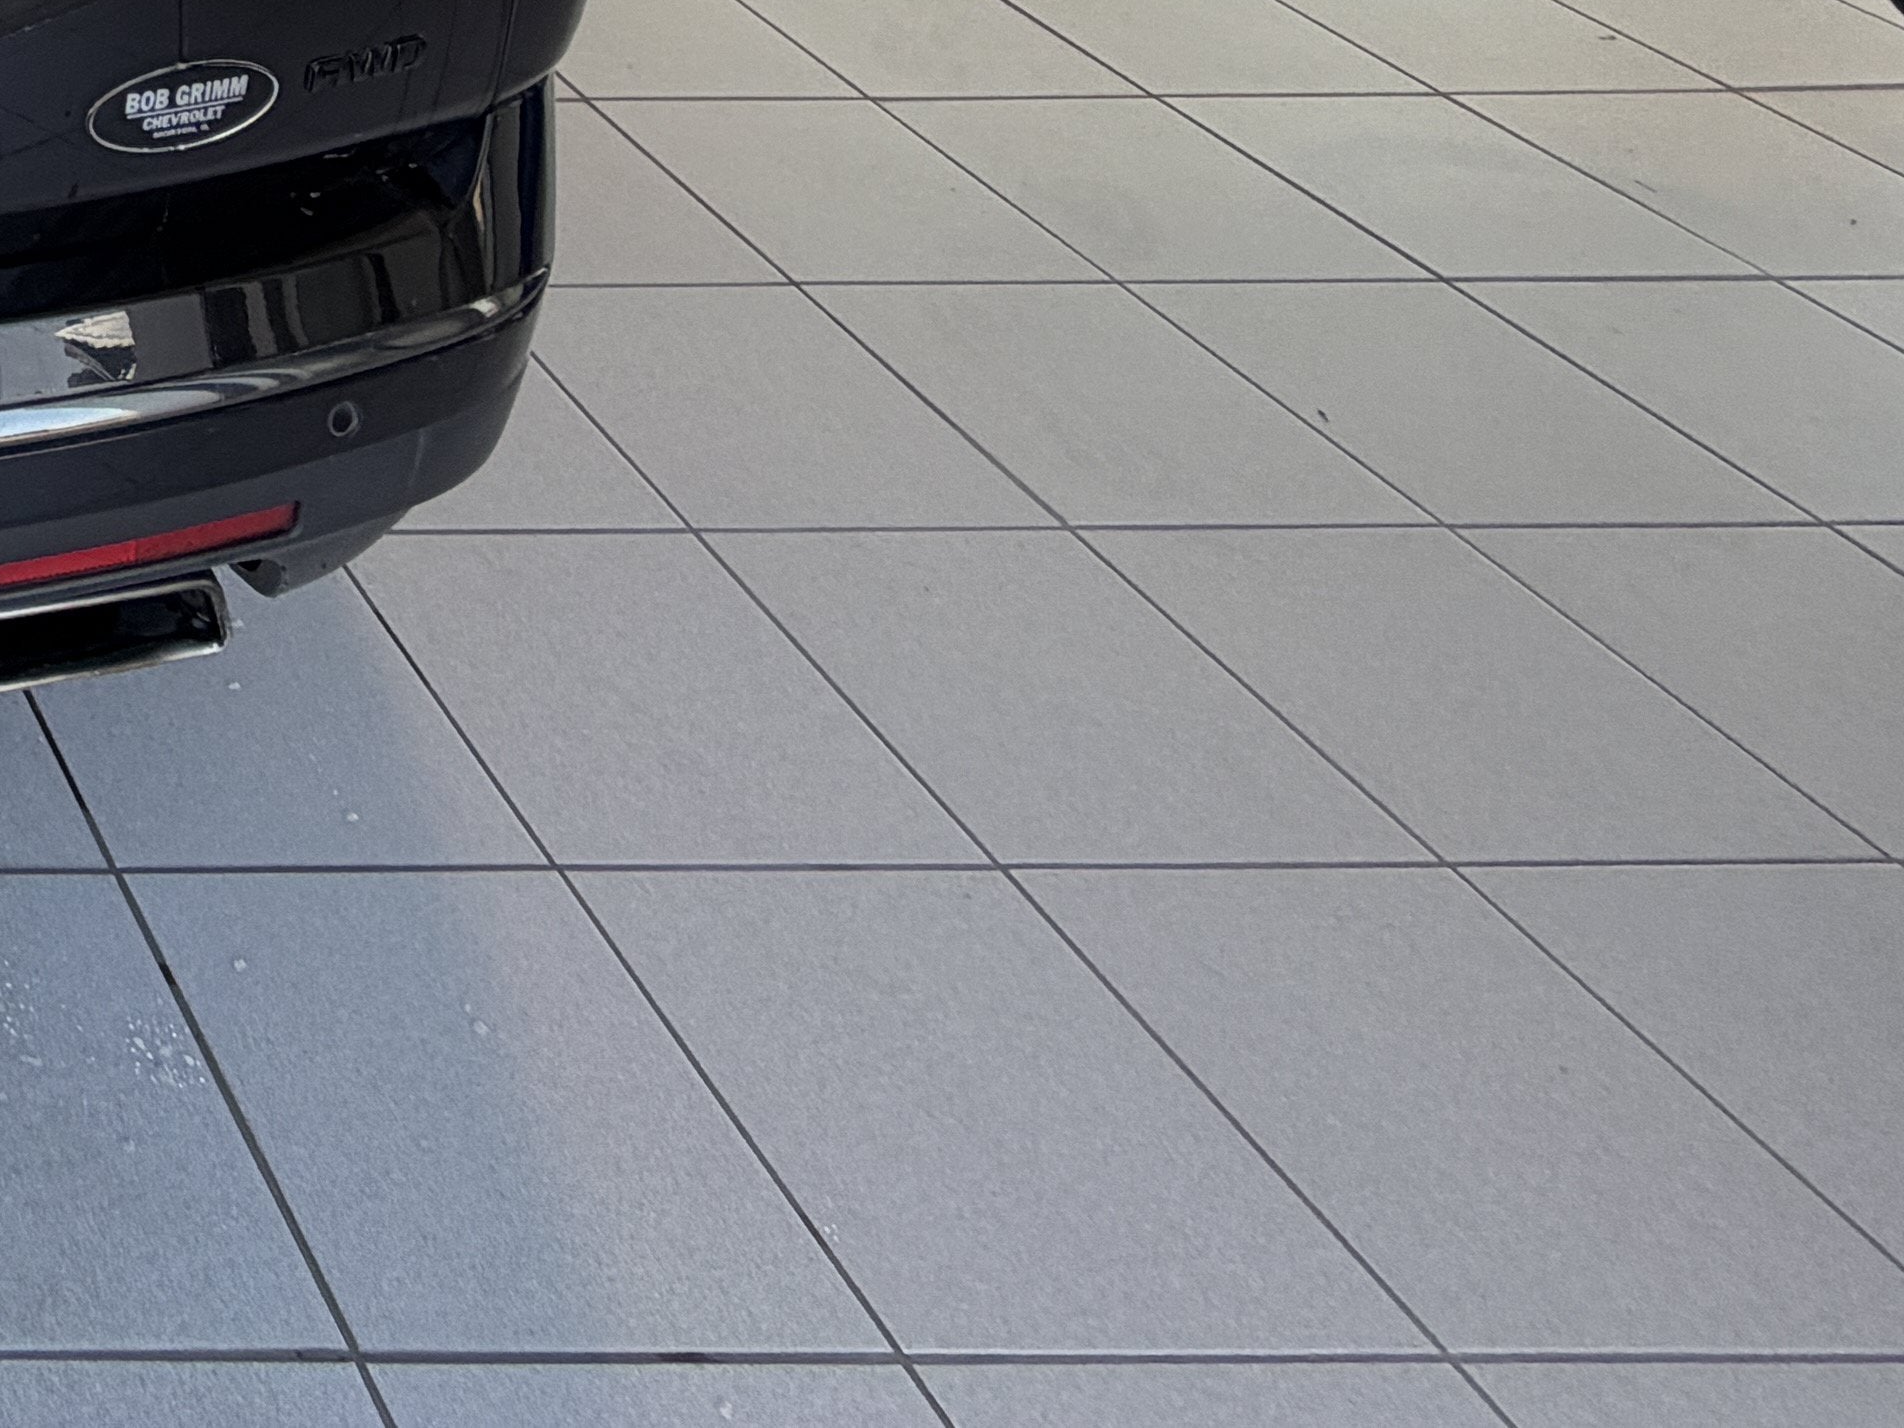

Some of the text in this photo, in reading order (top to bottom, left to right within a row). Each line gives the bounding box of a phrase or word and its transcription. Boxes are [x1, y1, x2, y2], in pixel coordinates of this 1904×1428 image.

[124, 73, 249, 115] BOB GRIMM
[142, 105, 226, 132] CHEVROLET
